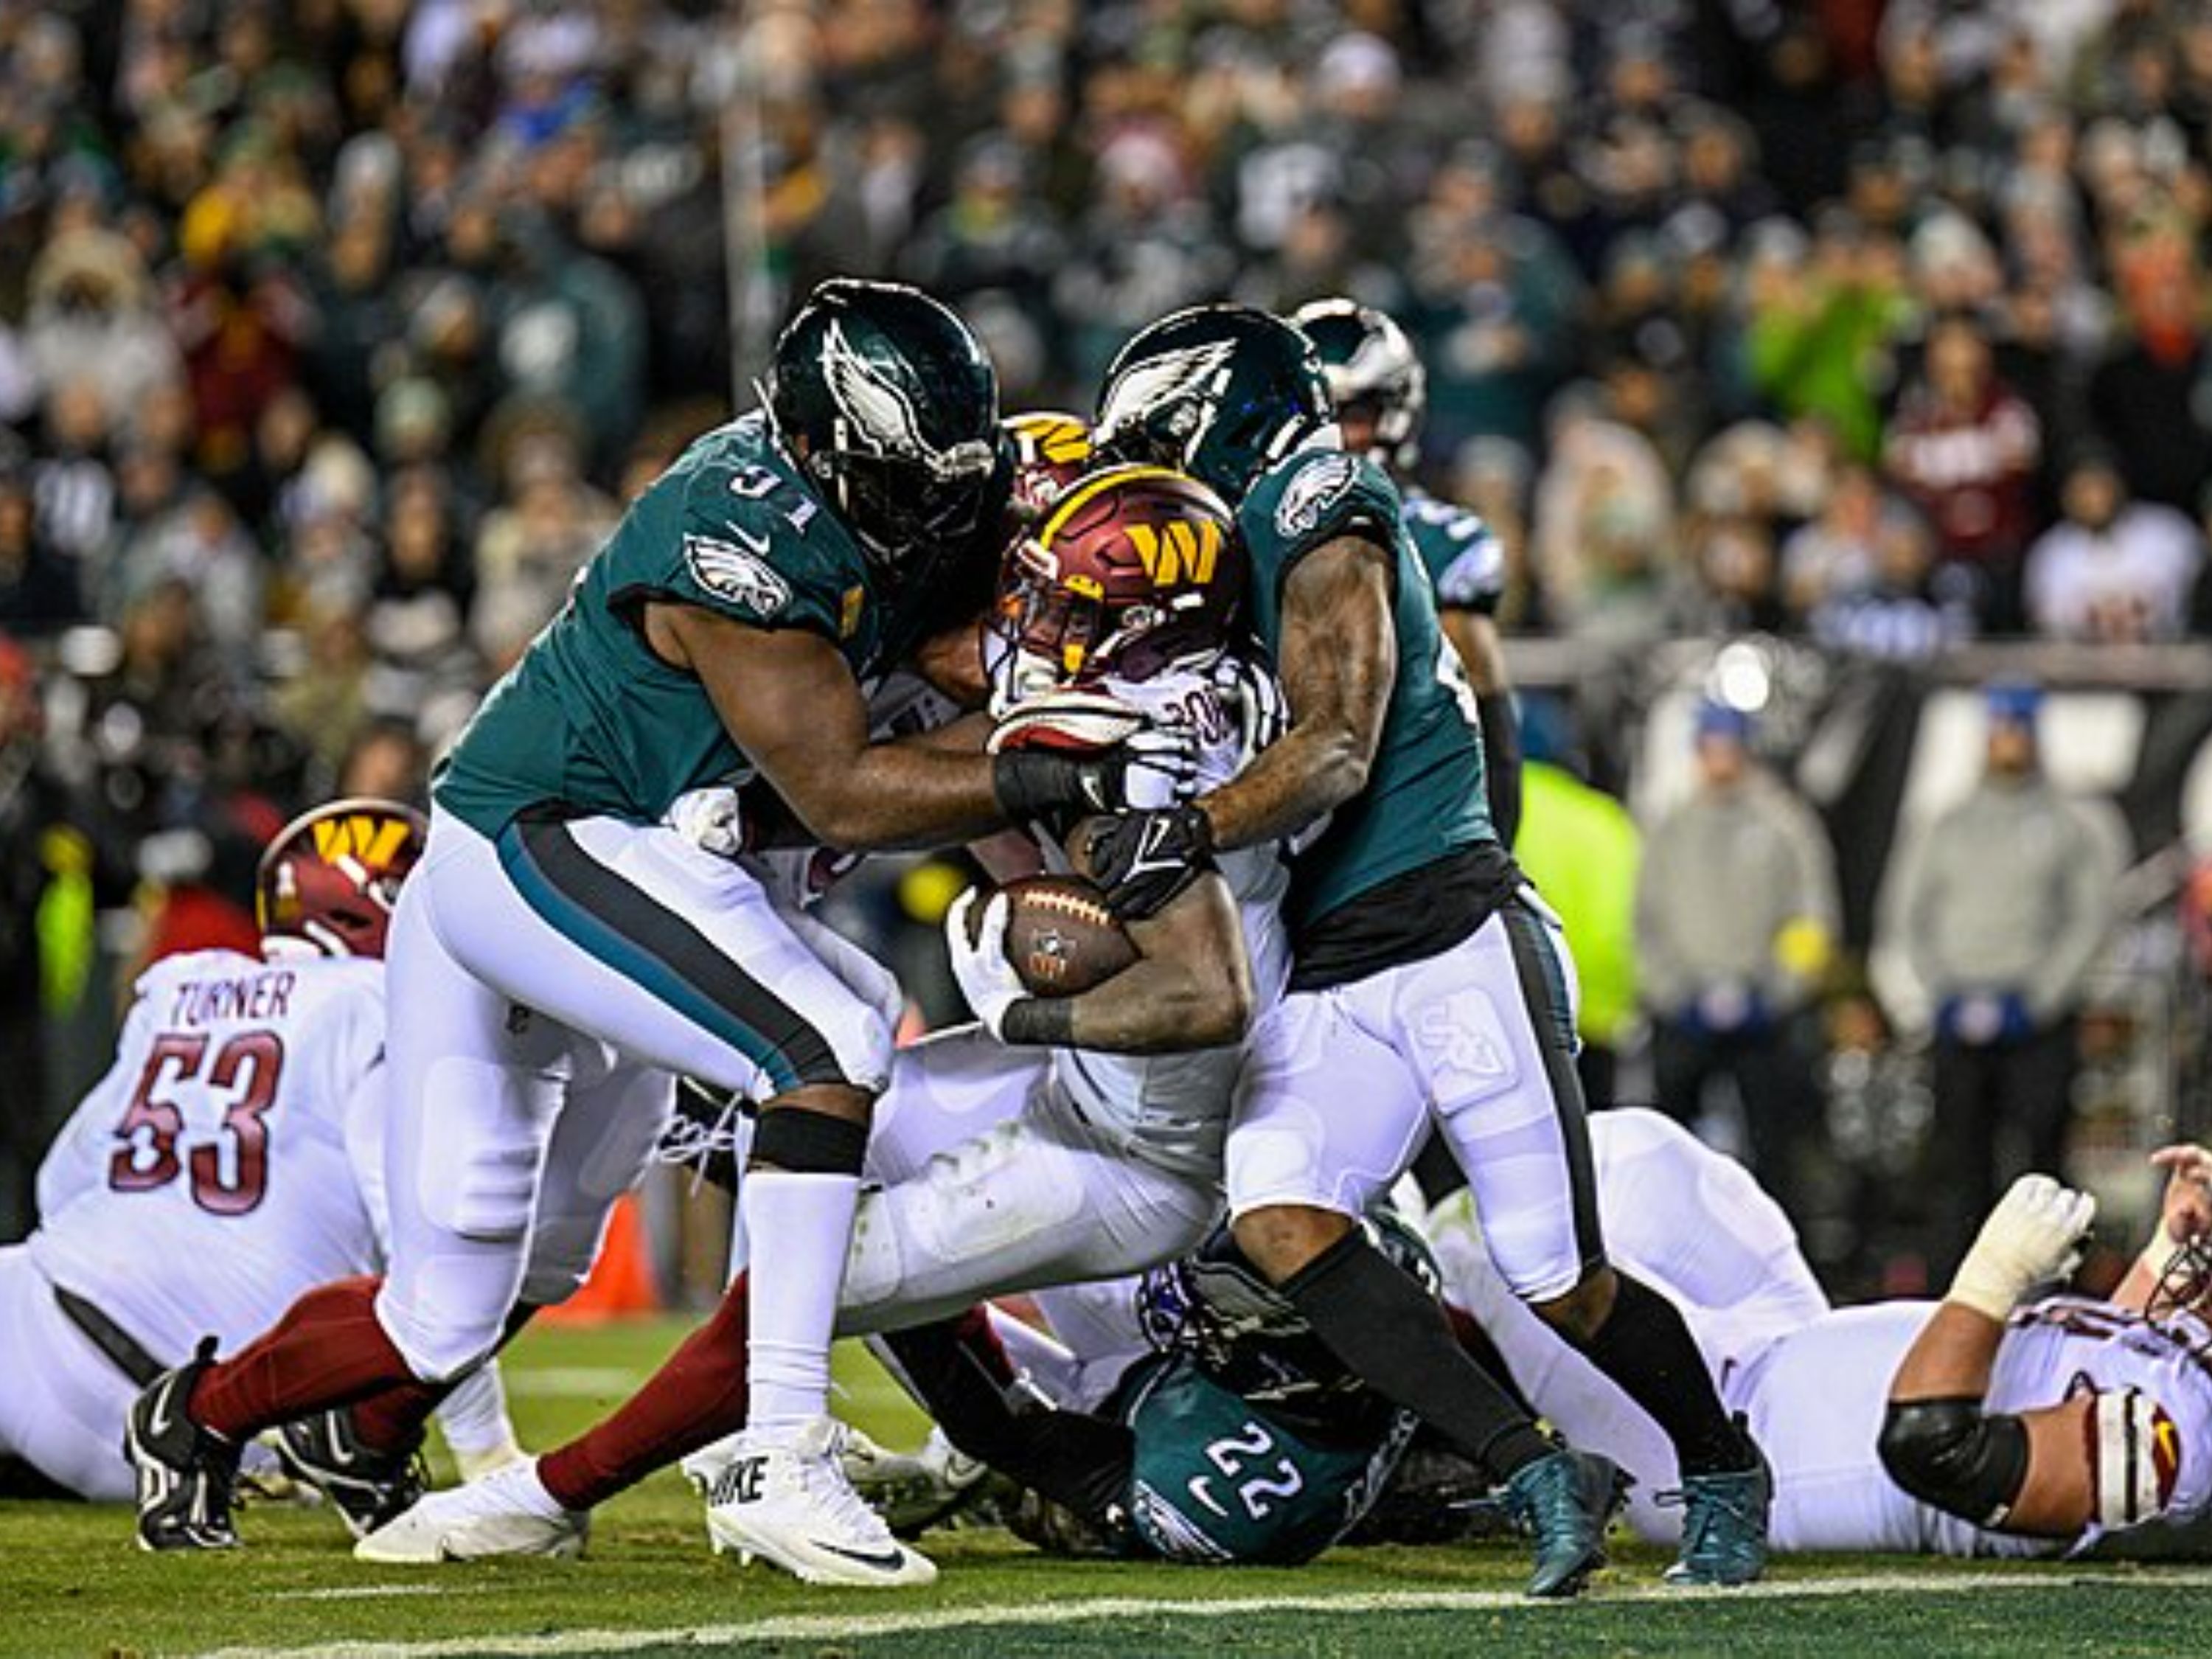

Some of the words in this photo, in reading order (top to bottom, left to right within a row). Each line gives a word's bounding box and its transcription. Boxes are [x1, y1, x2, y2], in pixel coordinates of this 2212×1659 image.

[169, 970, 297, 1026] TURNER
[107, 1029, 285, 1217] 53
[1204, 1420, 1304, 1520] 22
